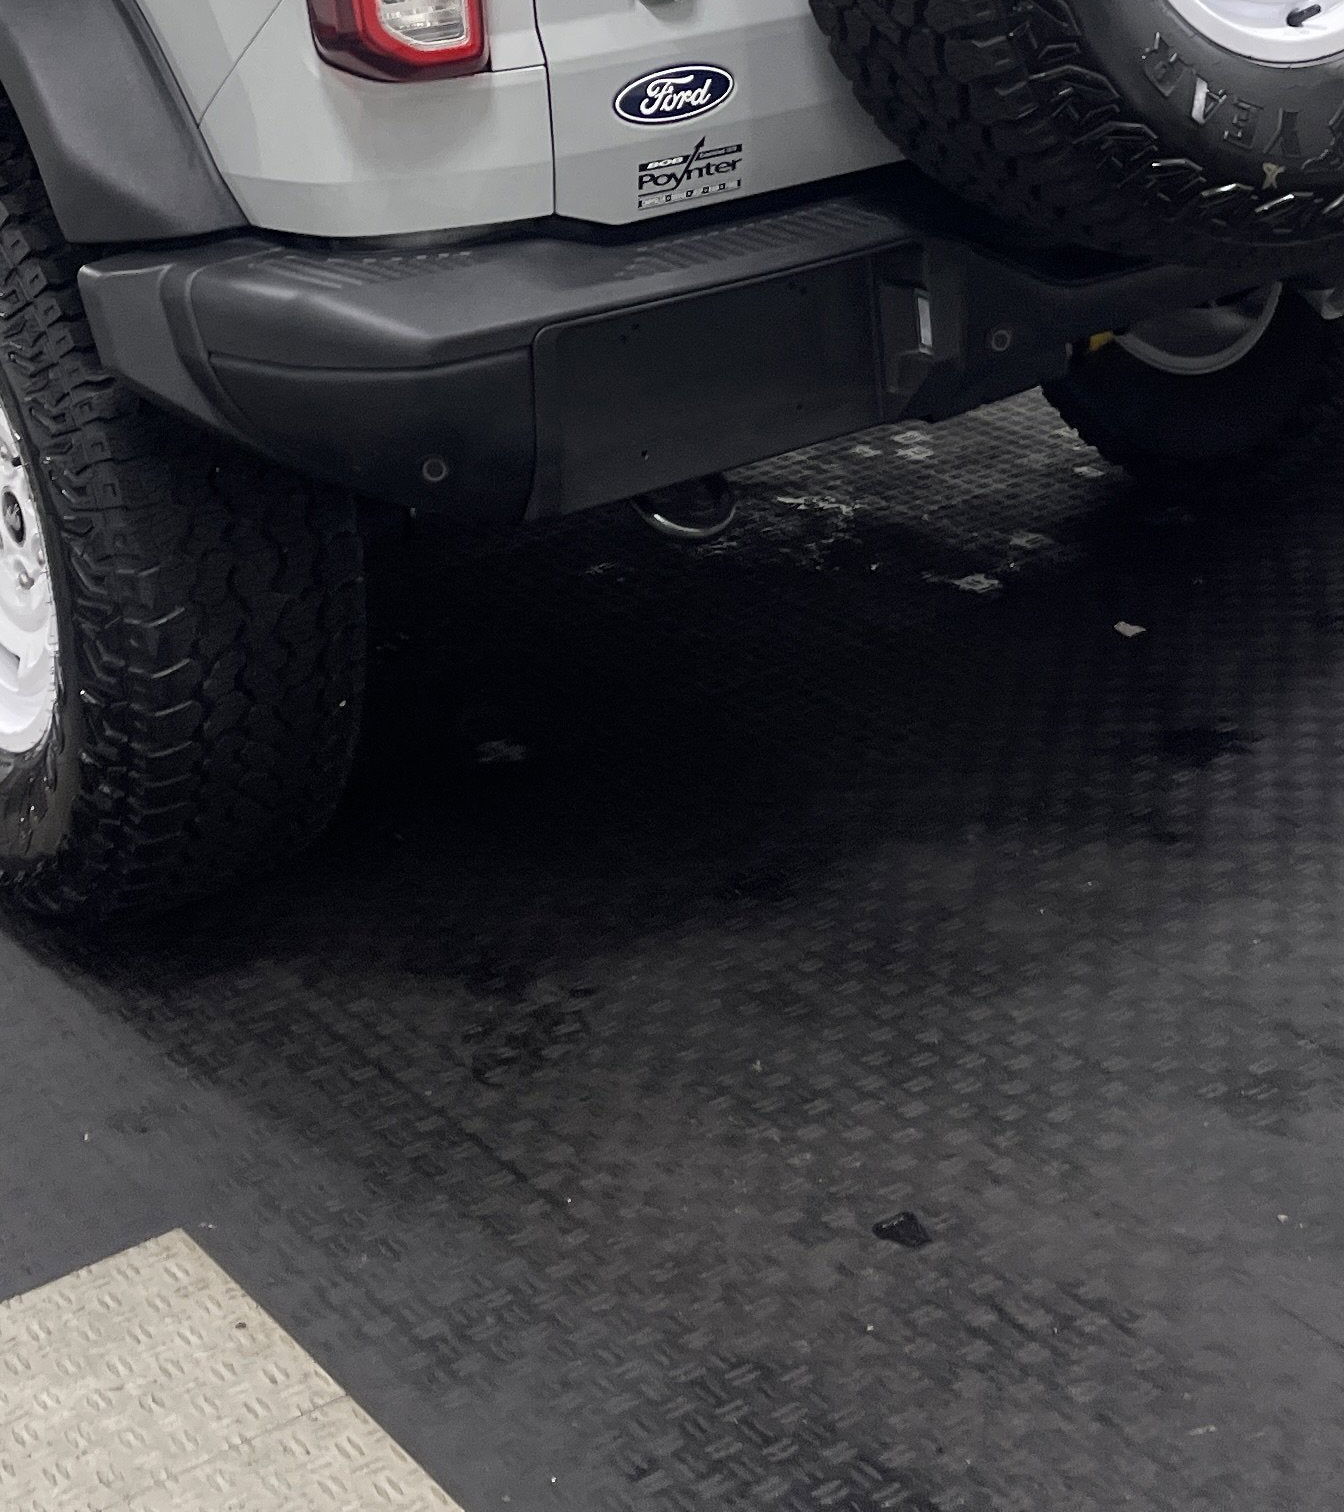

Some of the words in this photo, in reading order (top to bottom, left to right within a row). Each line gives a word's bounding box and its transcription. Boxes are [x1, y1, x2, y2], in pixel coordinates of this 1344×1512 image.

[639, 74, 713, 116] Ford
[638, 156, 743, 191] Poynter
[646, 156, 684, 170] BOB
